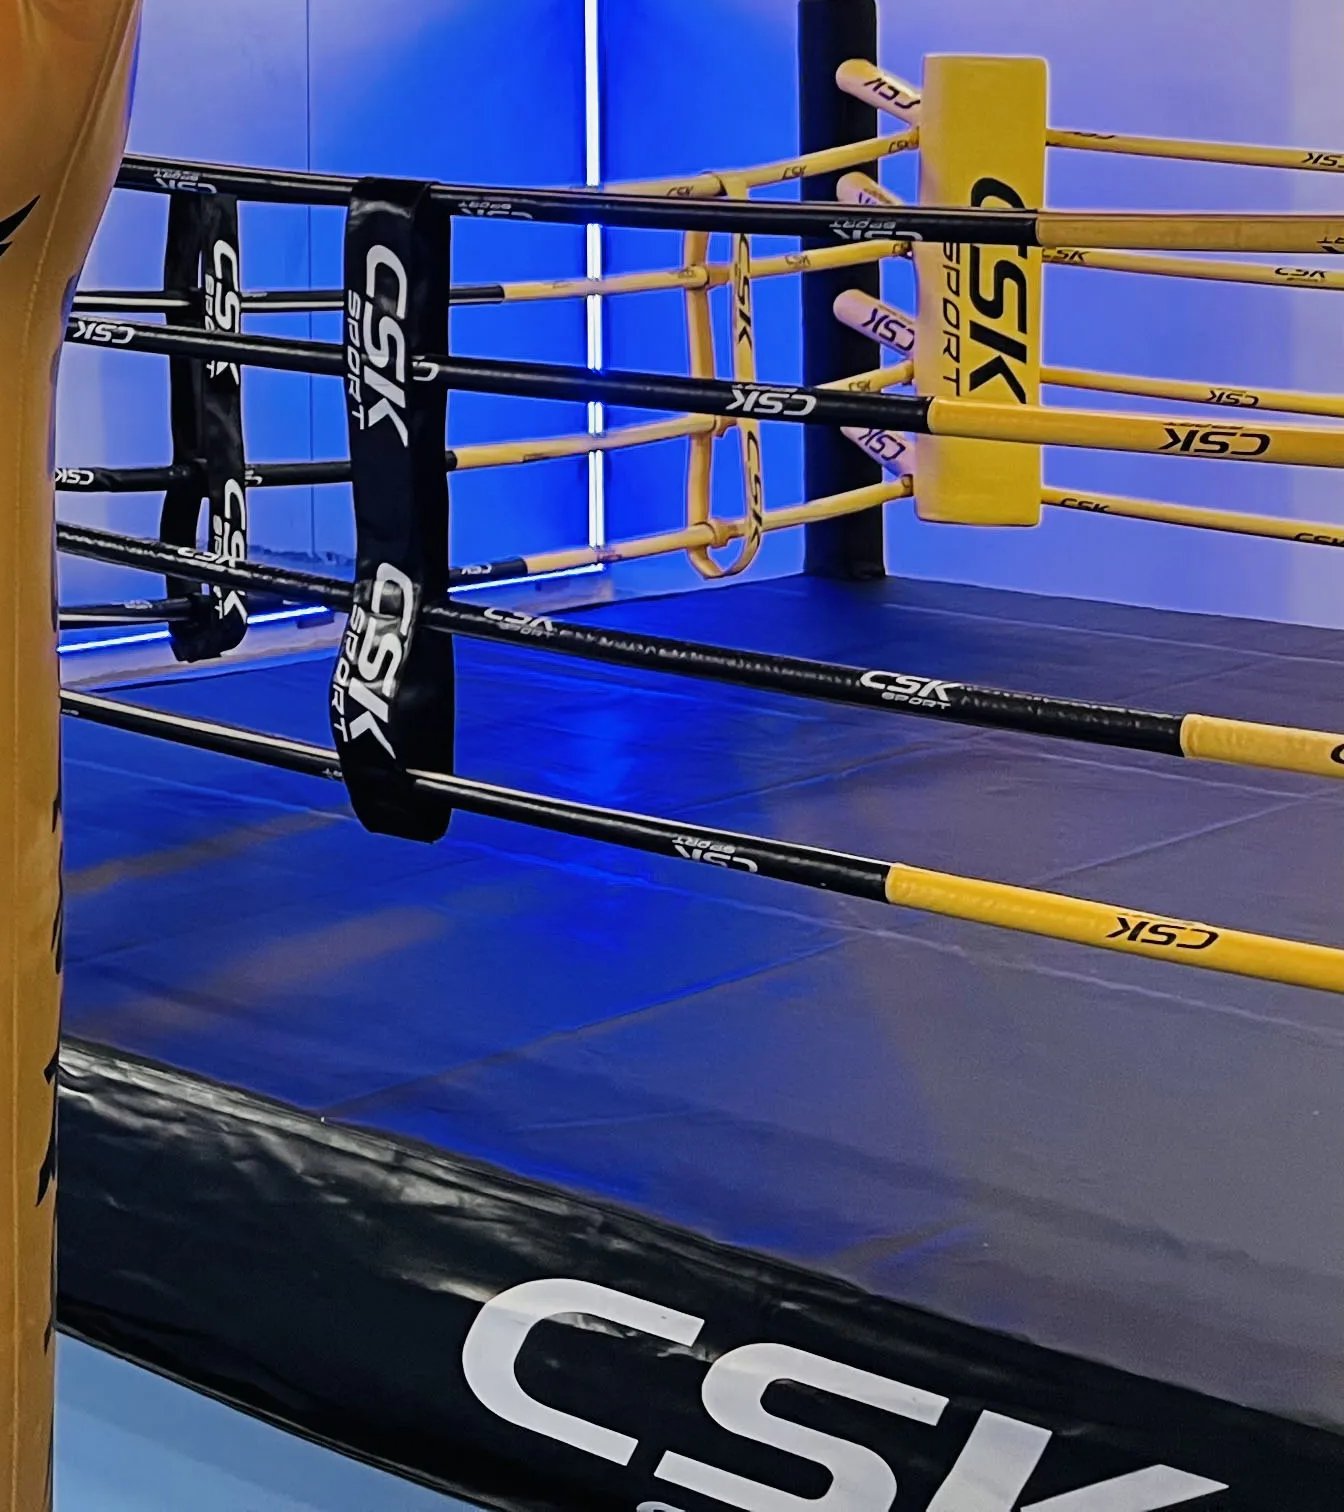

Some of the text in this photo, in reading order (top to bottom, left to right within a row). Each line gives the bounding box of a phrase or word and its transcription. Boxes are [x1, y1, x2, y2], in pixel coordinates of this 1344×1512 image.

[1301, 151, 1344, 169] SK
[969, 177, 1027, 405] CSK
[73, 320, 136, 344] CSK
[363, 244, 409, 448] CSK
[862, 307, 916, 352] CSK
[347, 289, 365, 430] SPORT
[726, 388, 817, 417] CSK
[1208, 389, 1260, 408] CSK
[1158, 427, 1271, 456] CSK
[331, 604, 366, 743] SPORT
[349, 562, 414, 760] CSK
[860, 669, 964, 702] CSK
[881, 691, 952, 710] SPORT
[671, 836, 736, 855] SPORT
[1106, 917, 1220, 950] CSK
